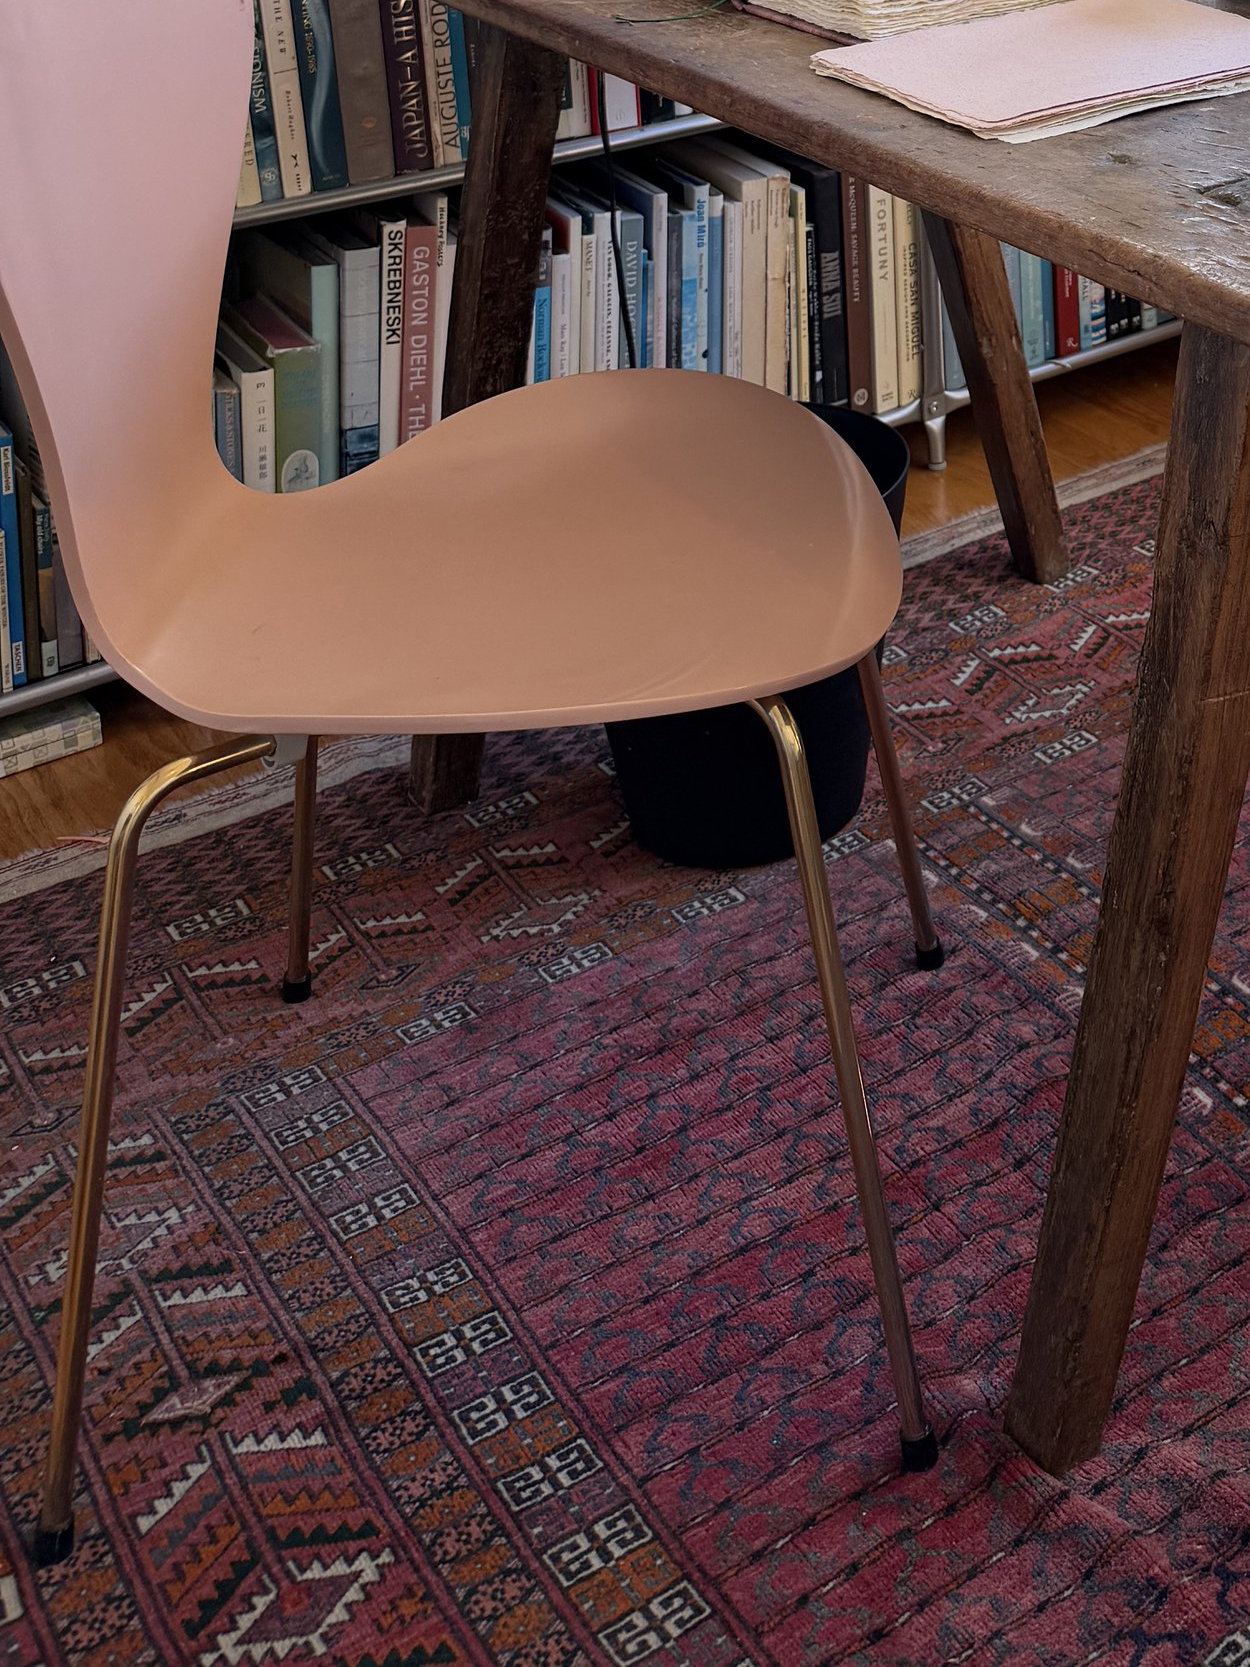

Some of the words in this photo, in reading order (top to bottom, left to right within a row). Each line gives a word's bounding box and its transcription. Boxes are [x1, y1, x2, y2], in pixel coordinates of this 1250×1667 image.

[276, 30, 287, 54] NEW
[284, 90, 293, 113] Robert
[436, 57, 460, 148] AUGUSTE
[286, 114, 296, 140] Hughes
[696, 198, 705, 222] Joan
[696, 225, 706, 247] Miró
[877, 198, 888, 279] FORTUNY
[626, 240, 637, 286] DAVID
[821, 250, 839, 292] ANNA
[908, 242, 917, 274] CASA
[386, 229, 403, 345] SKREBNESKI
[411, 246, 429, 325] GASTON
[909, 282, 918, 305] SAN
[536, 298, 547, 338] Norman
[823, 292, 840, 318] SUI
[909, 311, 920, 359] MIGUEL
[409, 334, 426, 390] DIEHL
[3, 448, 11, 459] Karl
[3, 461, 12, 491] Blossfeldt
[14, 643, 22, 671] TASCHEN
